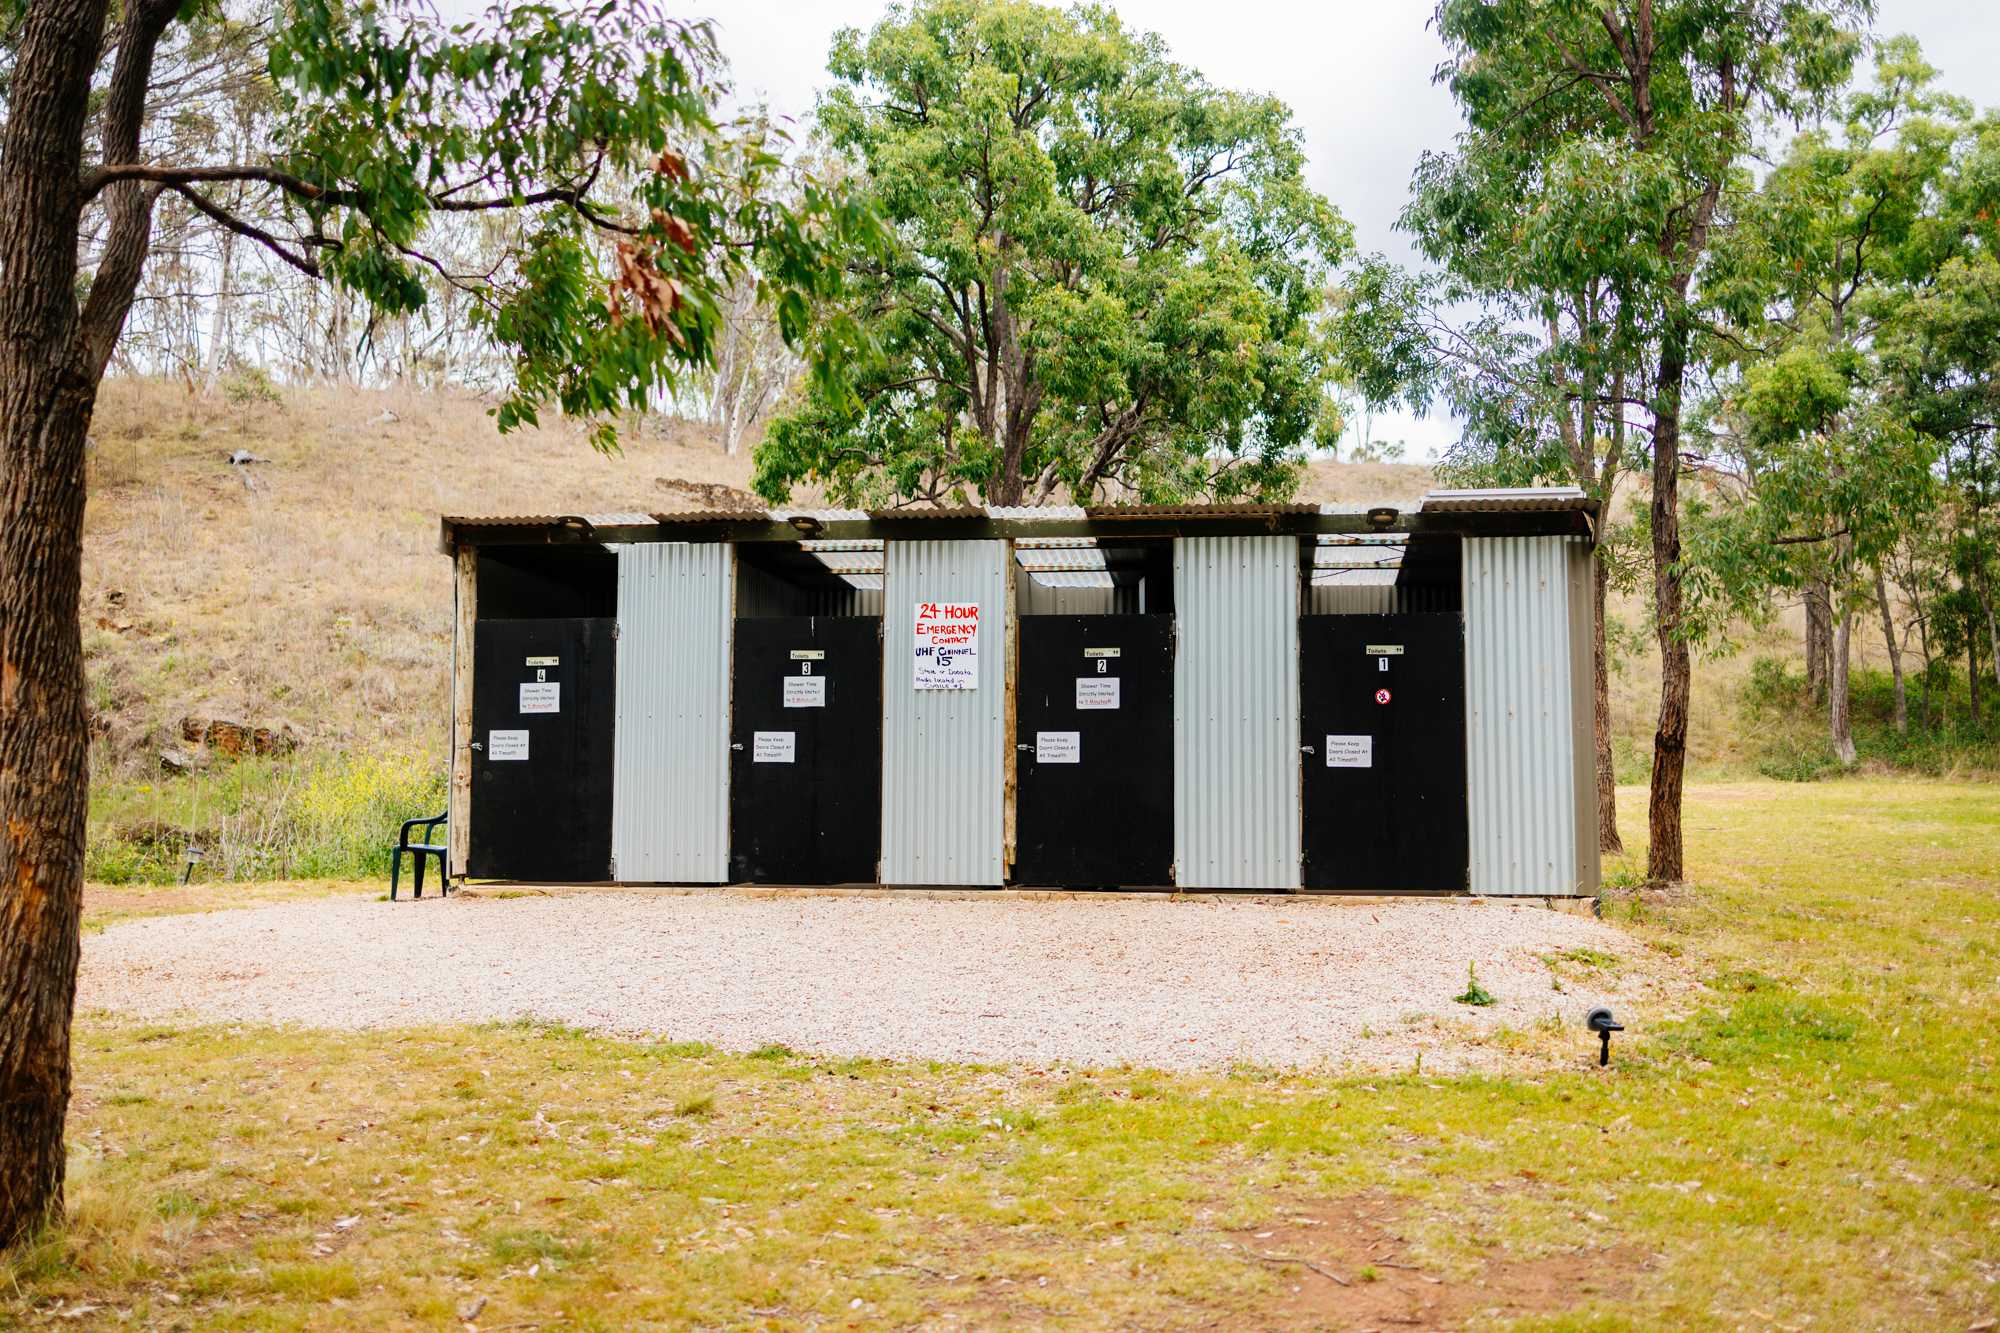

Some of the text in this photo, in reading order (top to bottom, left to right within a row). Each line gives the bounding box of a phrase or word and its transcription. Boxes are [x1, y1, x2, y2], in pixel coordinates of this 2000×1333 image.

[919, 602, 979, 621] 24 HOUR
[916, 623, 977, 637] EMERGENCY
[931, 636, 969, 645] CONTACT
[915, 646, 976, 656] UHF CHANNEL
[936, 656, 953, 667] 15
[1099, 661, 1105, 671] 2
[1381, 659, 1386, 670] 1
[803, 663, 809, 674] 3
[538, 671, 544, 680] 4
